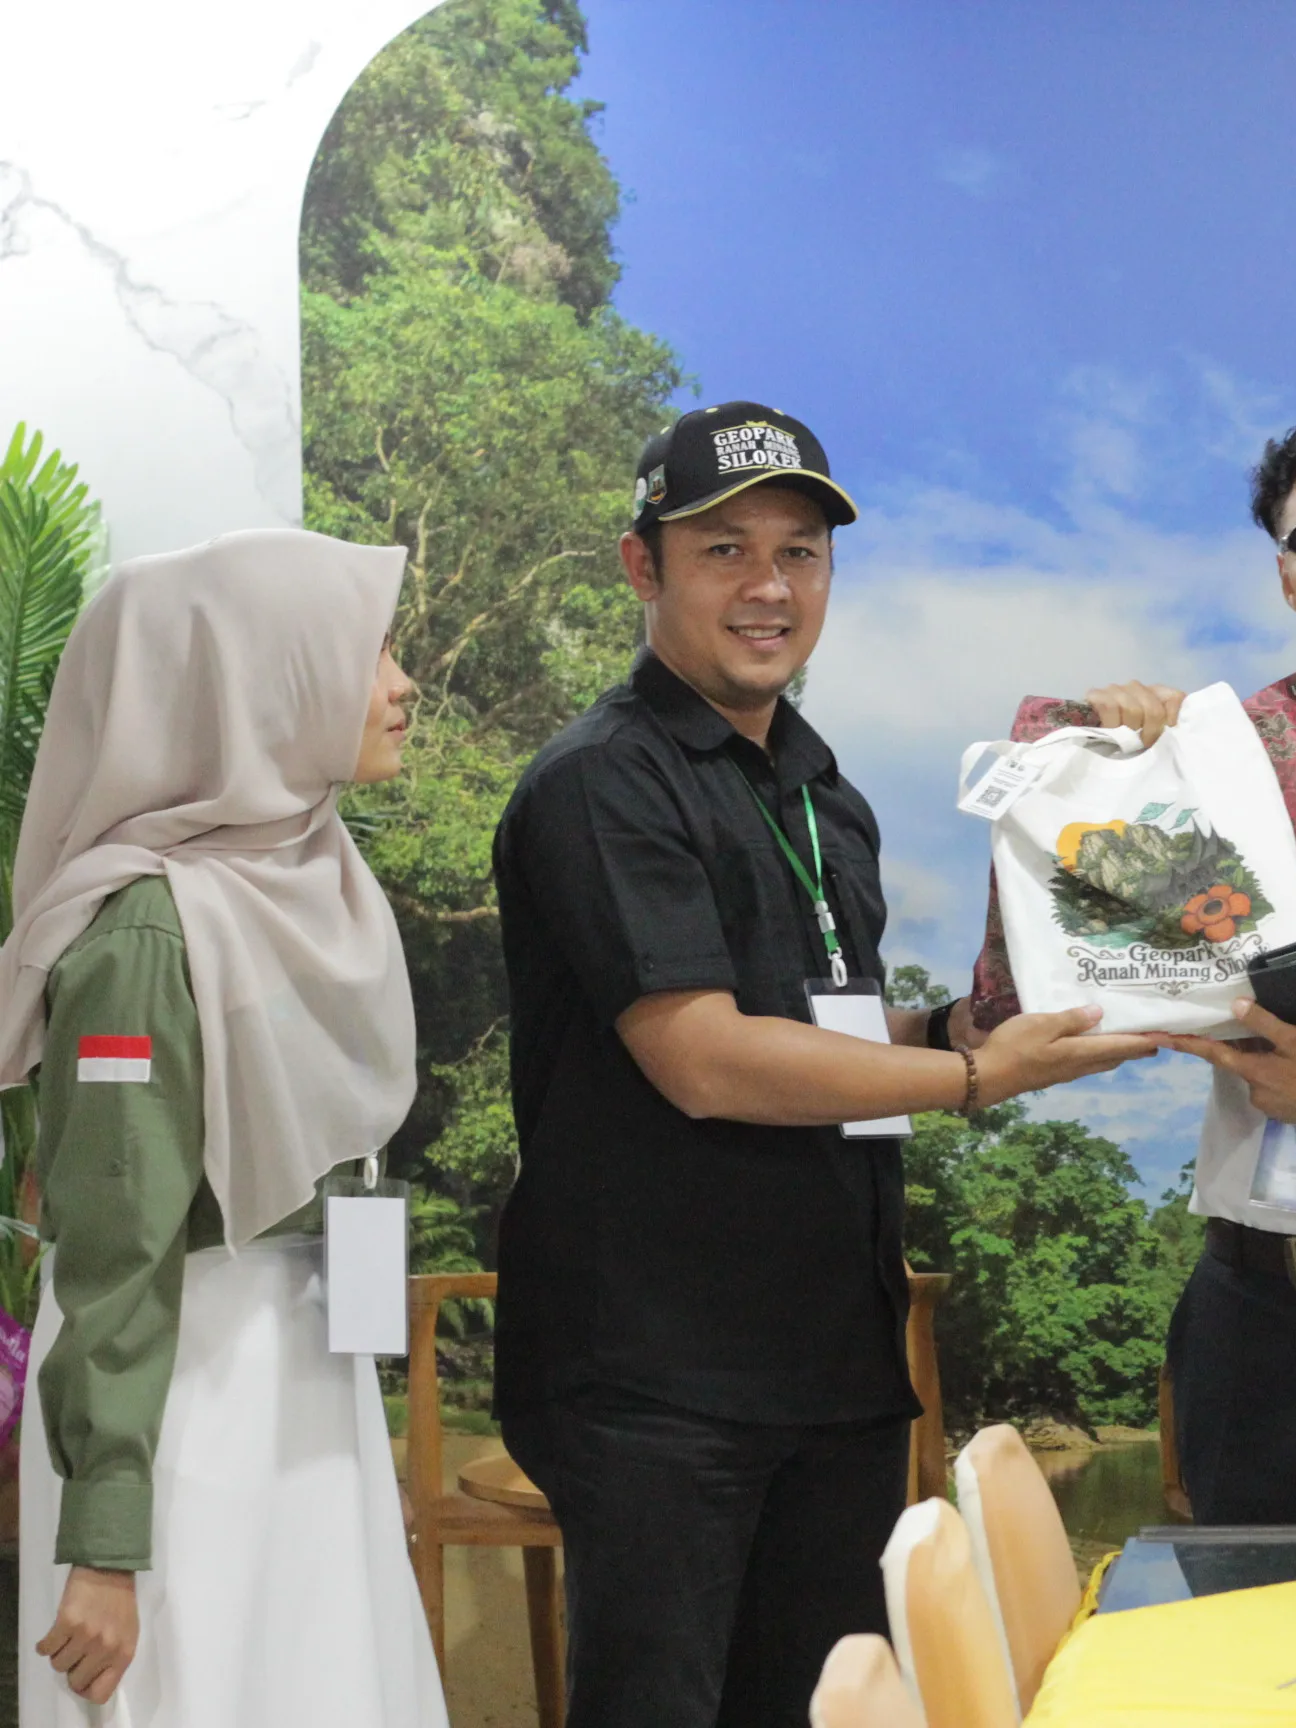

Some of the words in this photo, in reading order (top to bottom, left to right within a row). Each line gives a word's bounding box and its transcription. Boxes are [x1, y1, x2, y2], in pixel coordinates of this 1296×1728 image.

[713, 427, 798, 451] GEOPARK
[715, 440, 757, 456] RANAH
[718, 450, 802, 470] SILOKEK
[1129, 944, 1217, 964] Geopark
[1078, 957, 1140, 986] Ranah
[1144, 963, 1210, 981] Minang
